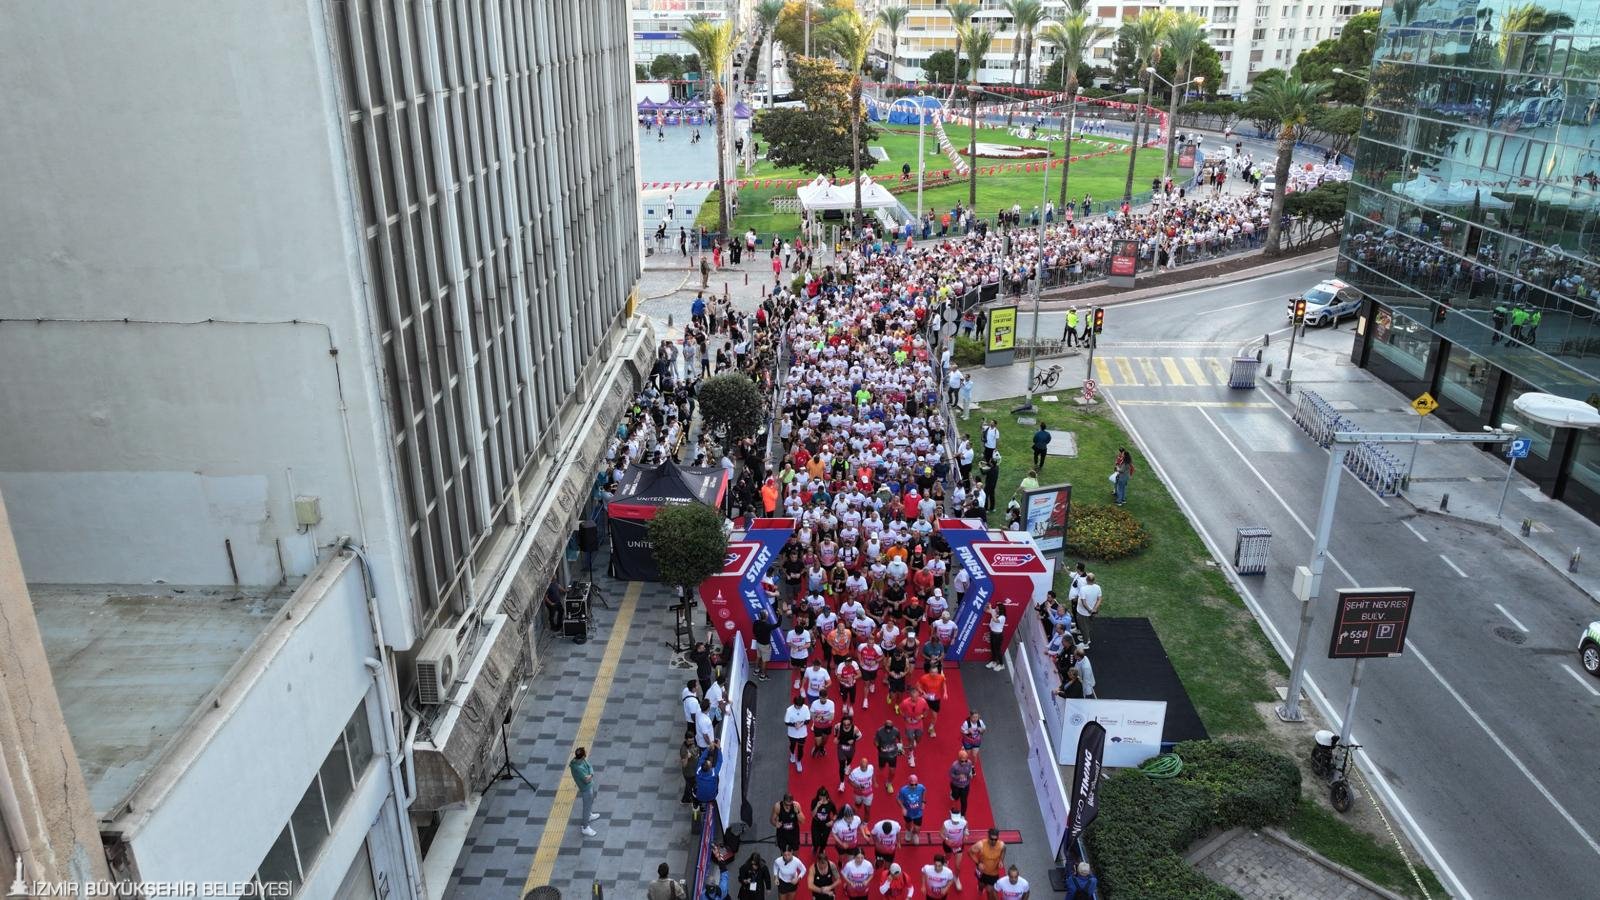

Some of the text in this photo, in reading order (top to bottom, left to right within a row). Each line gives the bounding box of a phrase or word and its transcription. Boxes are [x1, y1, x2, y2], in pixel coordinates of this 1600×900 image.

[746, 545, 772, 582] START
[956, 546, 986, 580] FINISH
[744, 590, 762, 610] 21K
[972, 586, 989, 610] 21K
[1346, 600, 1370, 610] ŞEHİT
[1380, 626, 1390, 636] P
[1080, 749, 1093, 796] TIMING
